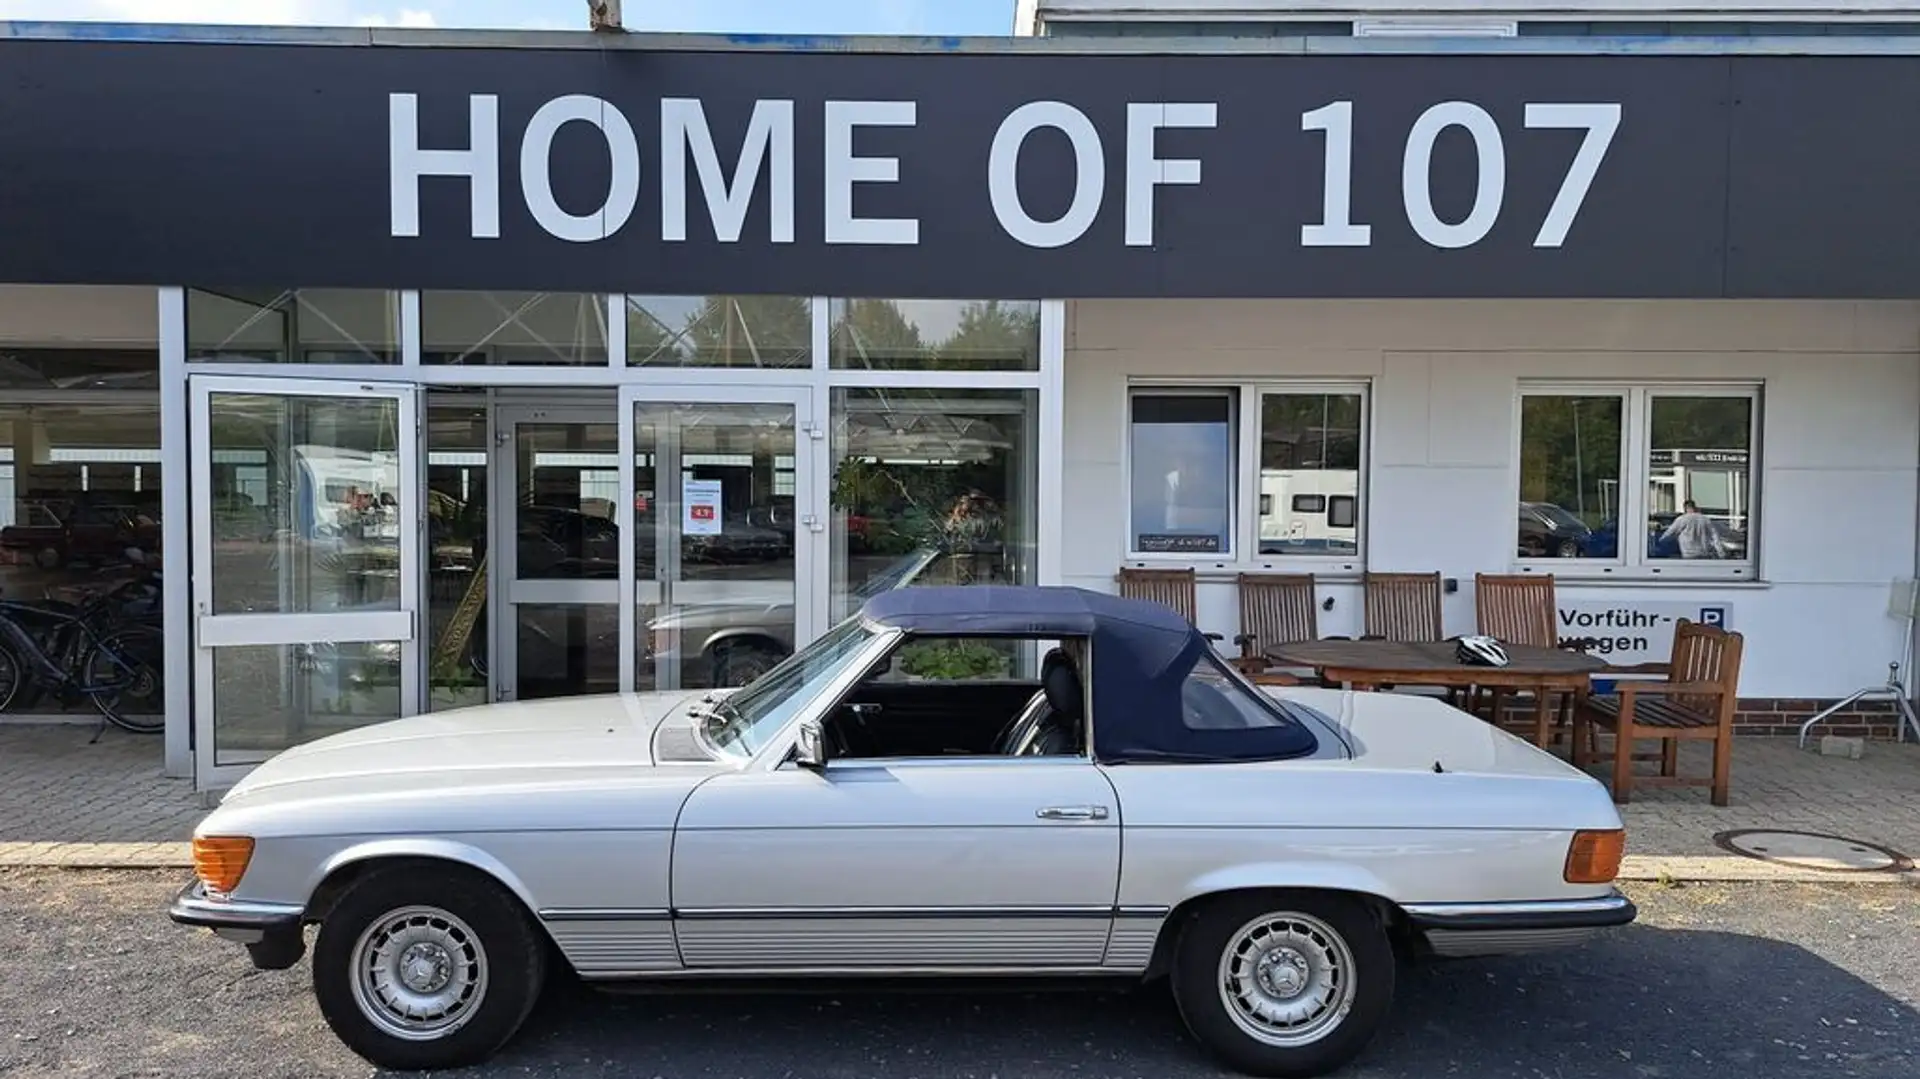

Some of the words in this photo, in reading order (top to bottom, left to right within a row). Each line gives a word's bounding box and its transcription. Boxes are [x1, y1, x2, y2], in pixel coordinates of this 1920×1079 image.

[389, 92, 920, 245] HOME
[988, 100, 1219, 248] OF
[1300, 101, 1623, 248] 107
[1558, 608, 1671, 628] Vorführ-
